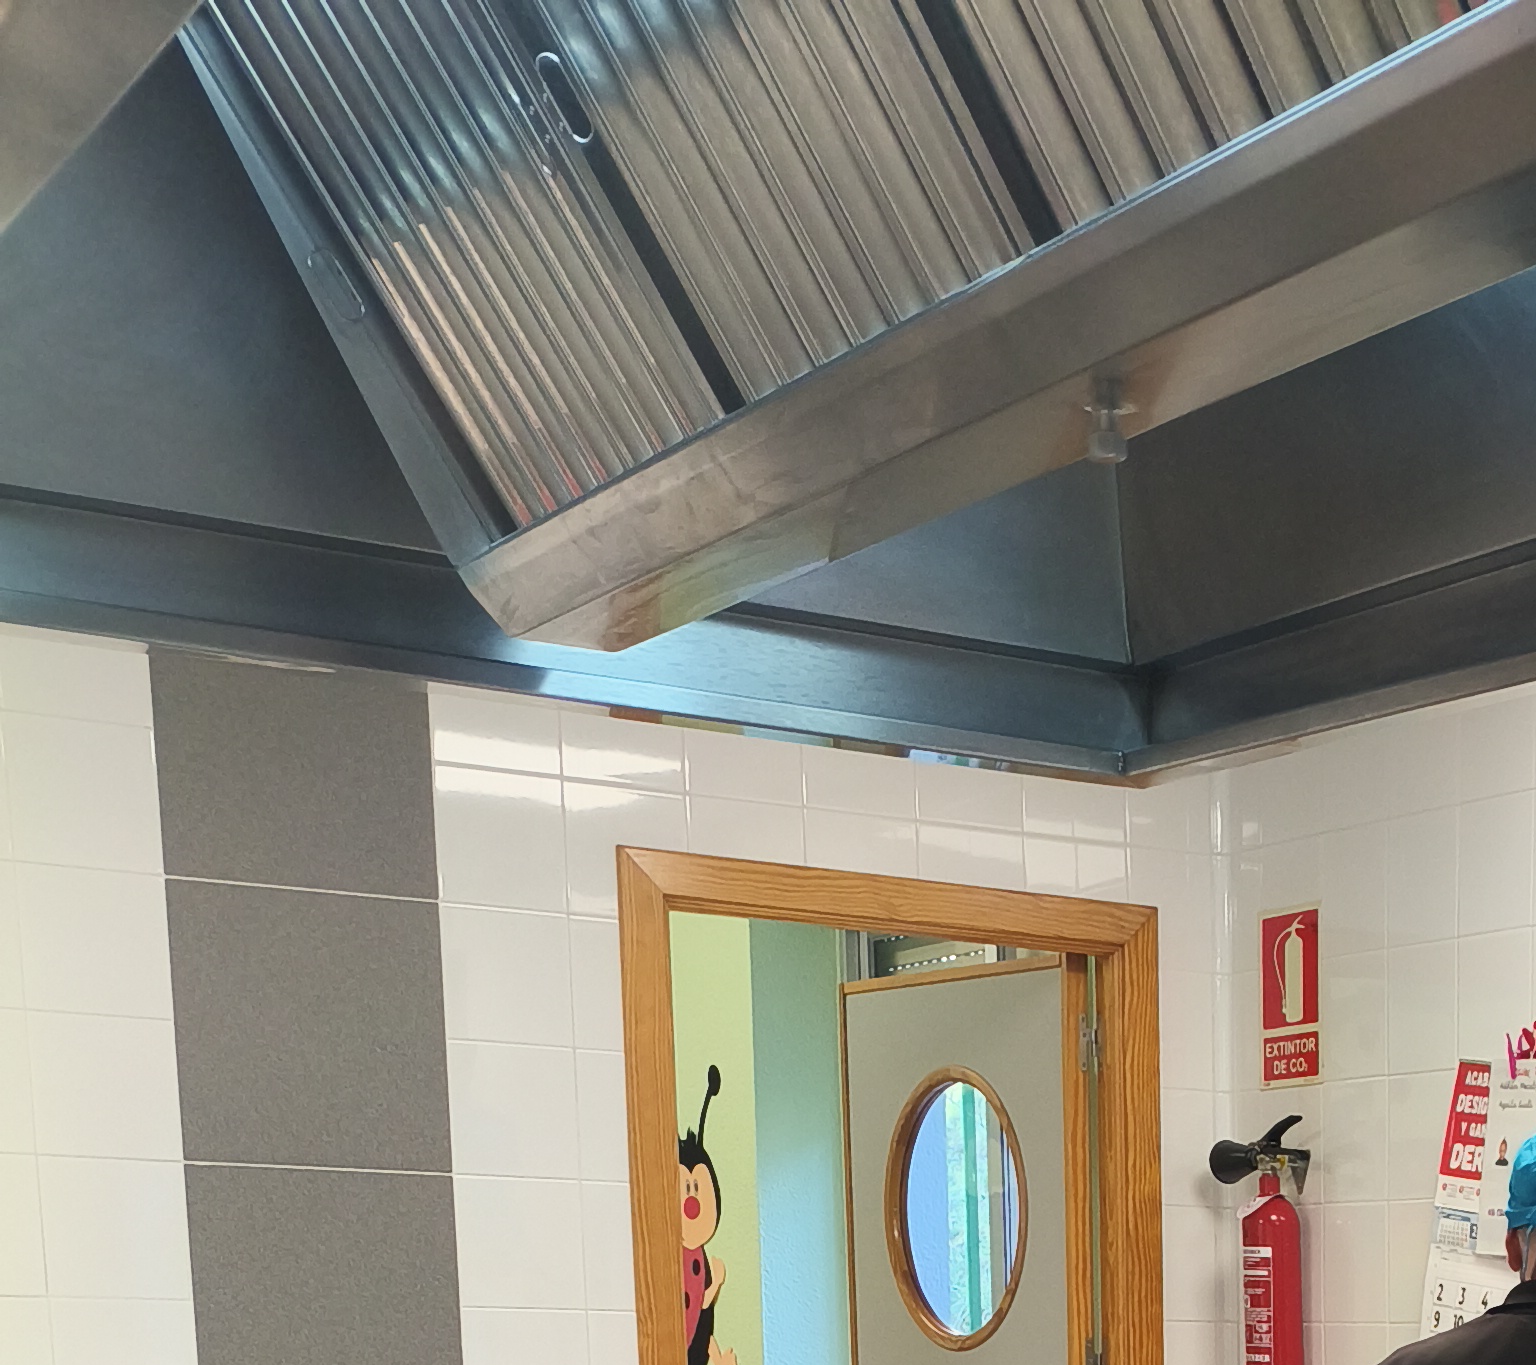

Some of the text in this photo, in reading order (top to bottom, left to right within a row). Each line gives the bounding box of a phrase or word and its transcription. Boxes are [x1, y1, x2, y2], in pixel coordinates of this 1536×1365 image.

[1265, 1037, 1316, 1058] EXTINTOR
[1273, 1059, 1287, 1075] DE
[1460, 1121, 1468, 1136] Y
[1436, 1283, 1489, 1310] 2 3 4
[1433, 1311, 1465, 1329] 9 10
